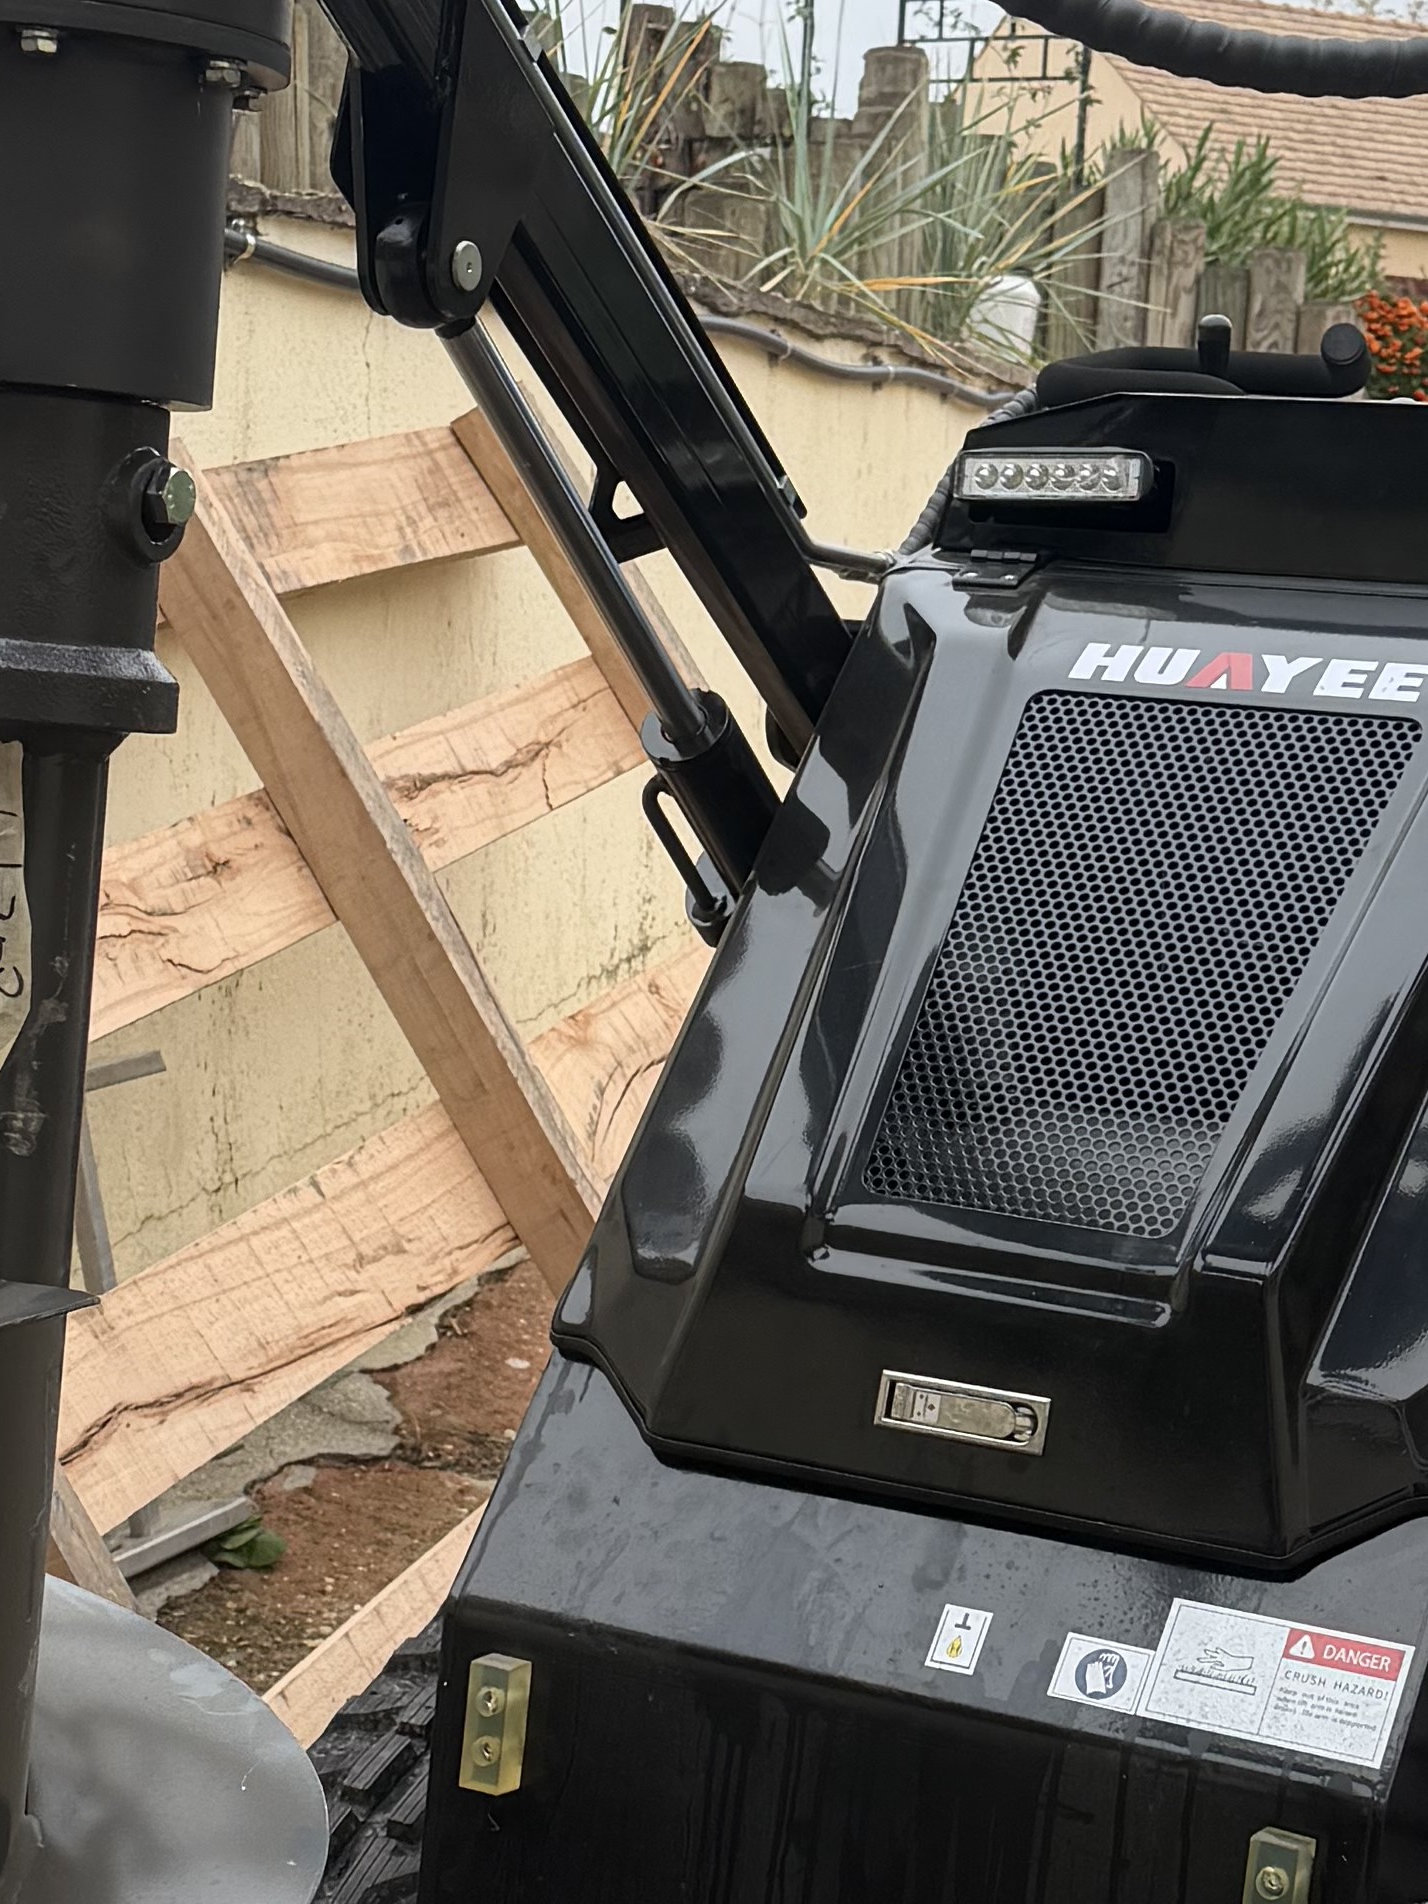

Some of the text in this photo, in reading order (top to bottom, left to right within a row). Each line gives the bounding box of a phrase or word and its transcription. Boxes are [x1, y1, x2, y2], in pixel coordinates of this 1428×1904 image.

[1323, 1644, 1391, 1672] DANGER
[1284, 1670, 1389, 1701] CRUSH HAZARD!
